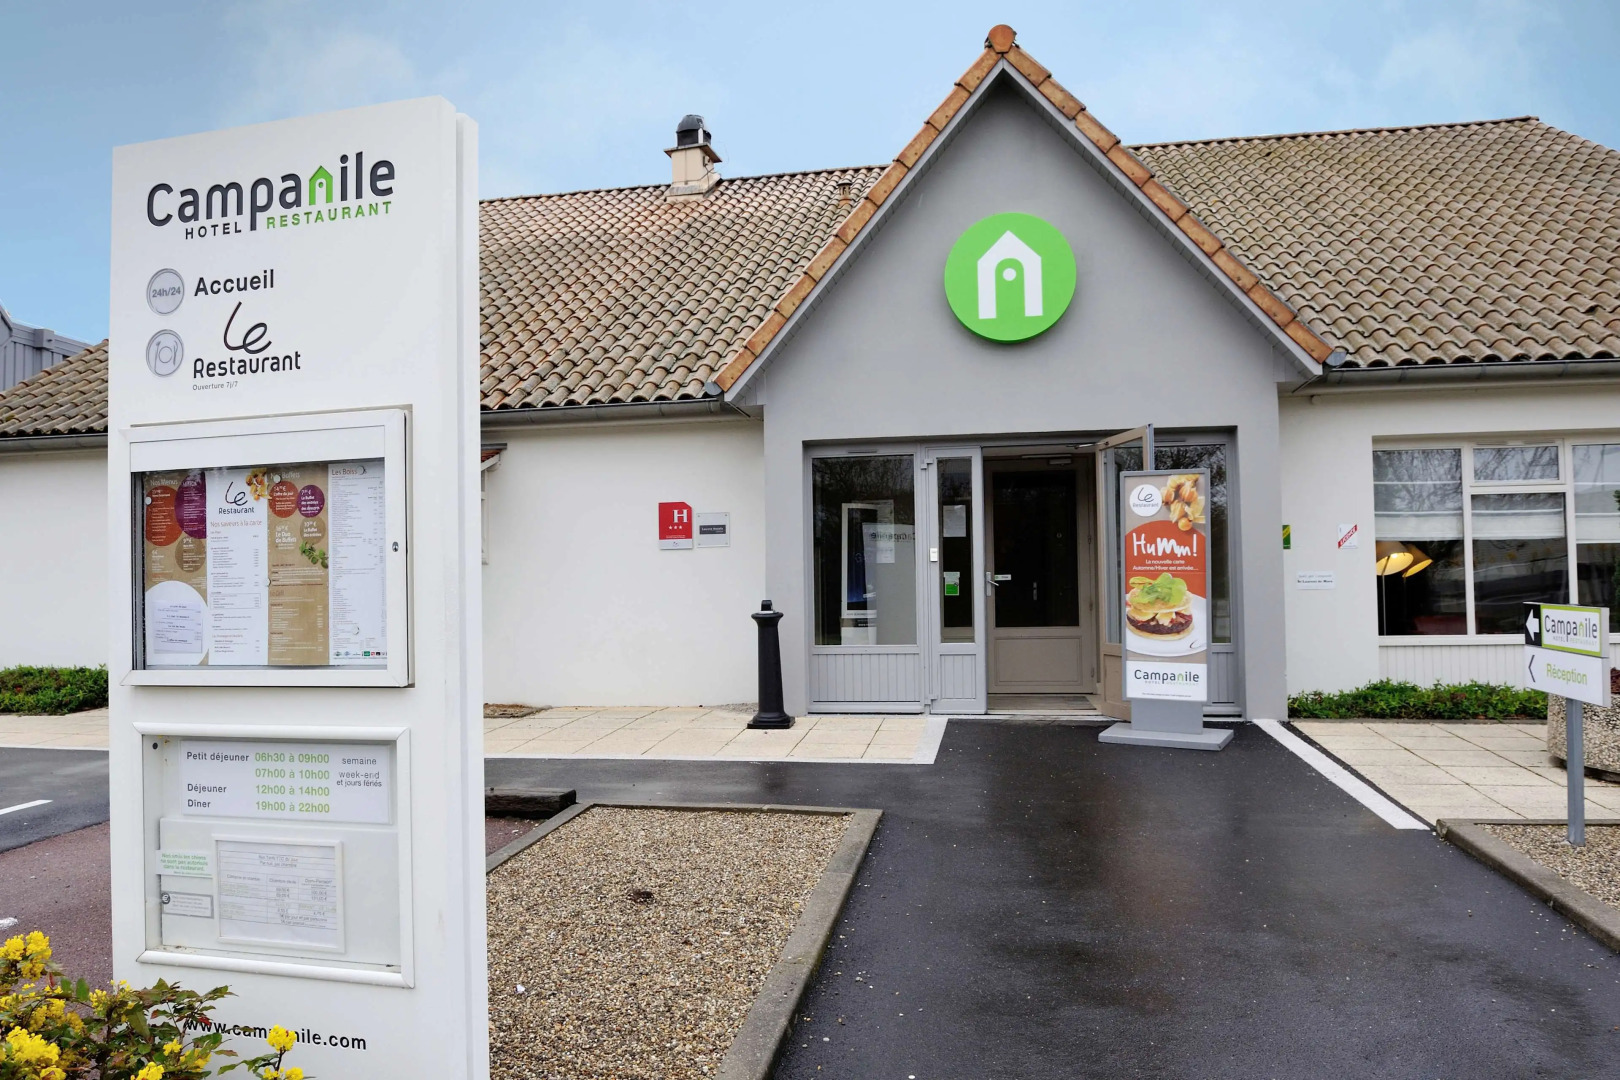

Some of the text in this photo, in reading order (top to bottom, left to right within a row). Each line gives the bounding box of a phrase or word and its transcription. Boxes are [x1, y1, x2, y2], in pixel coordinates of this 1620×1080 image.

[147, 151, 395, 231] Campanile
[185, 202, 392, 240] HOTEL RESTAURANT
[194, 269, 274, 296] Accueil
[152, 286, 181, 298] 24h/24
[224, 301, 272, 354] Le
[193, 351, 300, 378] Restaurant
[192, 382, 224, 390] Ouverture
[225, 481, 248, 506] Le
[1138, 487, 1154, 502] Le
[218, 506, 254, 514] Restaurant
[673, 509, 688, 522] H
[1544, 615, 1598, 642] Campanile
[1134, 669, 1199, 684] Campanile
[1546, 663, 1587, 685] Réception
[187, 751, 377, 765] Petit déjeuner 06h30 à 09h00 semaine
[255, 769, 380, 780] 07h00 à 10h00 week-end
[187, 783, 330, 796] Déjeuner 12h00 à 14h00
[256, 801, 285, 811] 19h00
[289, 802, 295, 811] à
[299, 802, 330, 813] 22h00
